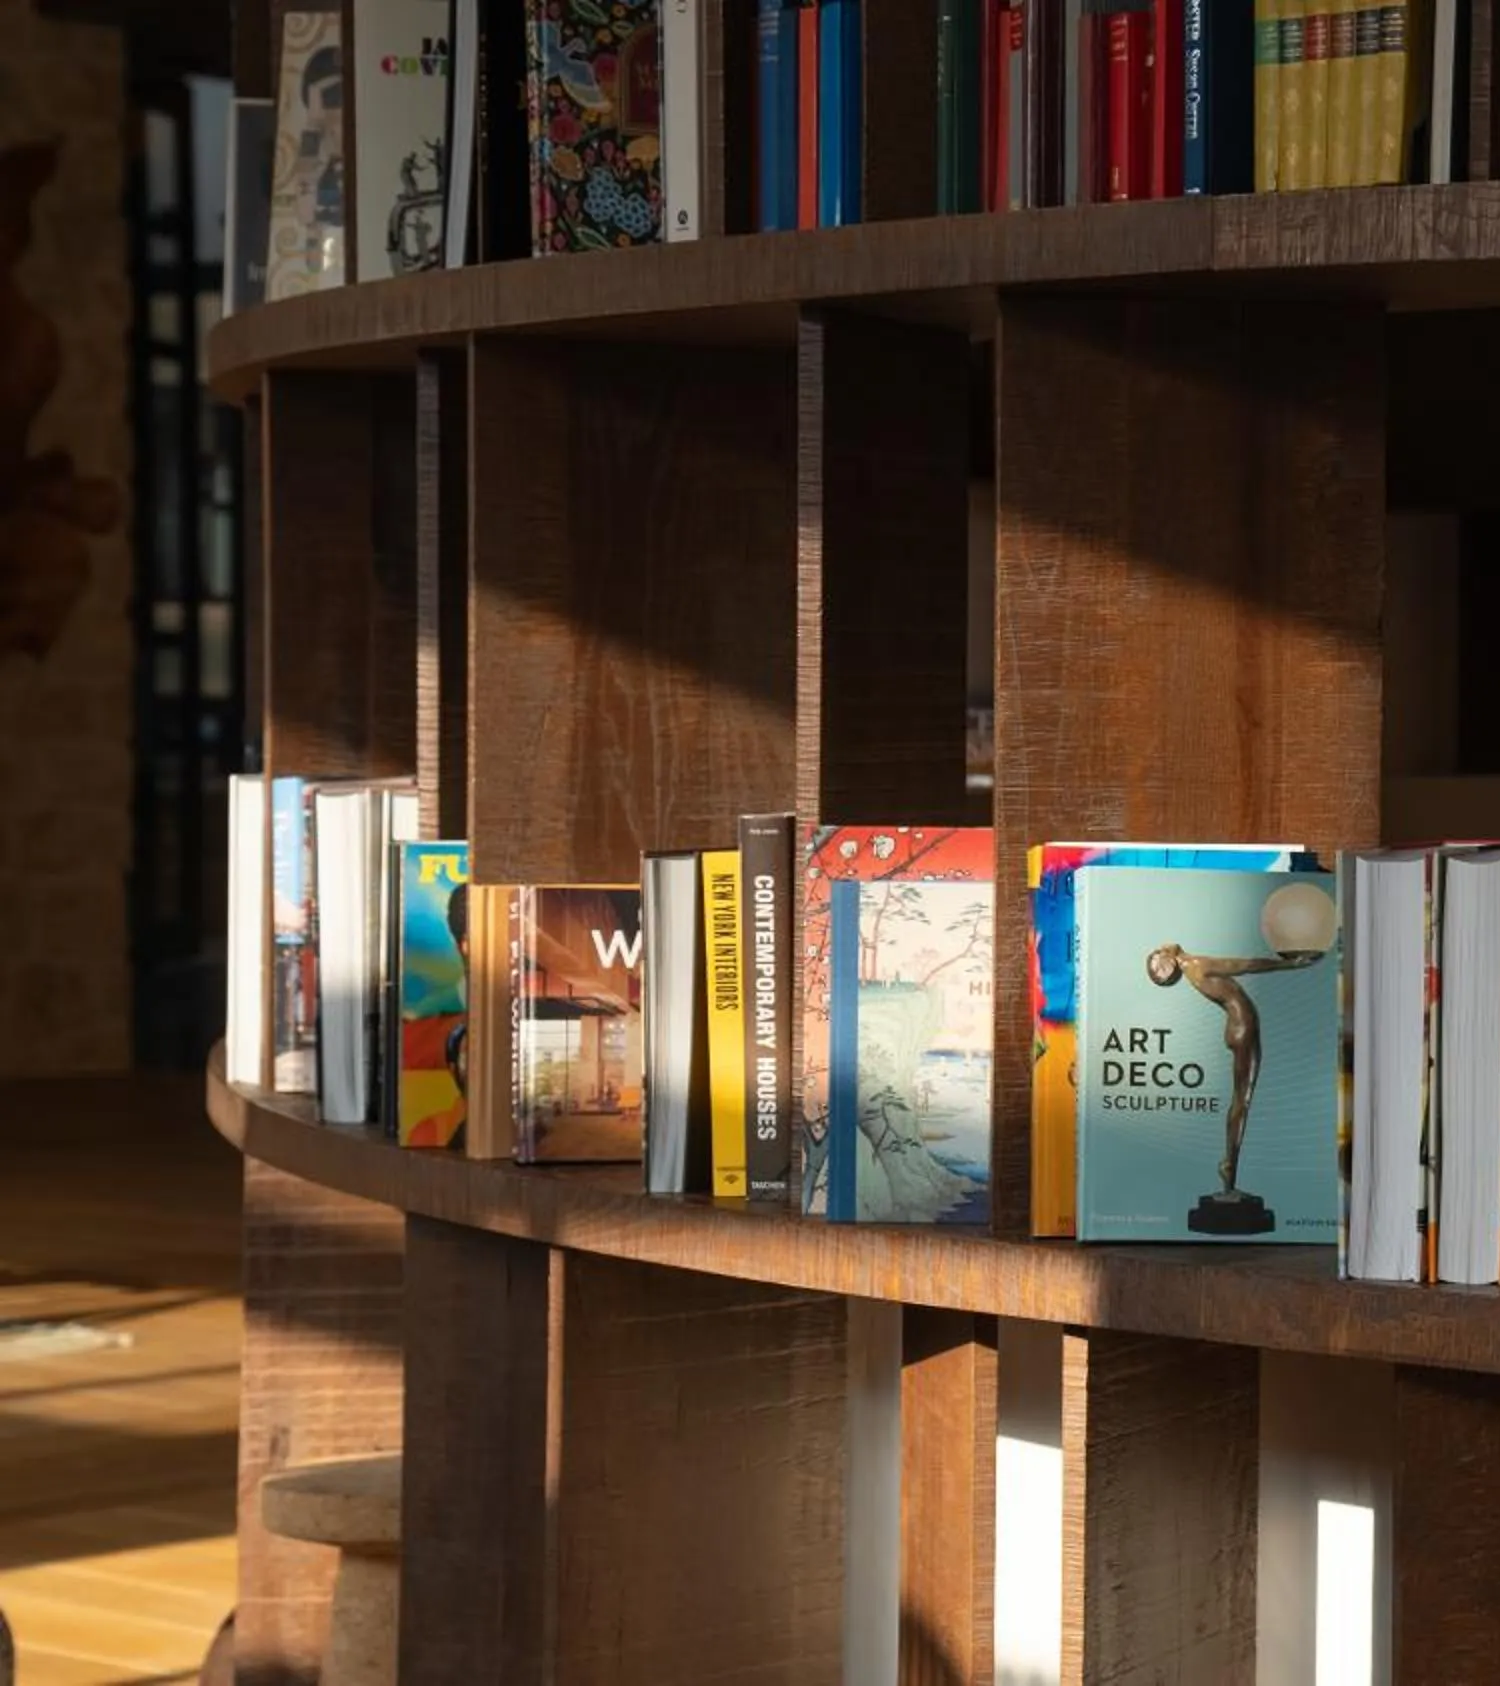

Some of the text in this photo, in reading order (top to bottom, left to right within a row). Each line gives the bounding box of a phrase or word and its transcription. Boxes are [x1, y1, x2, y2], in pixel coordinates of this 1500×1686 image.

[711, 873, 740, 1011] NEW YORK INTERIORS
[753, 875, 778, 1141] CONTEMPORARY HOUSES
[1103, 1027, 1173, 1054] ART
[1102, 1060, 1205, 1089] DECO
[1101, 1094, 1220, 1113] SCULPTURE
